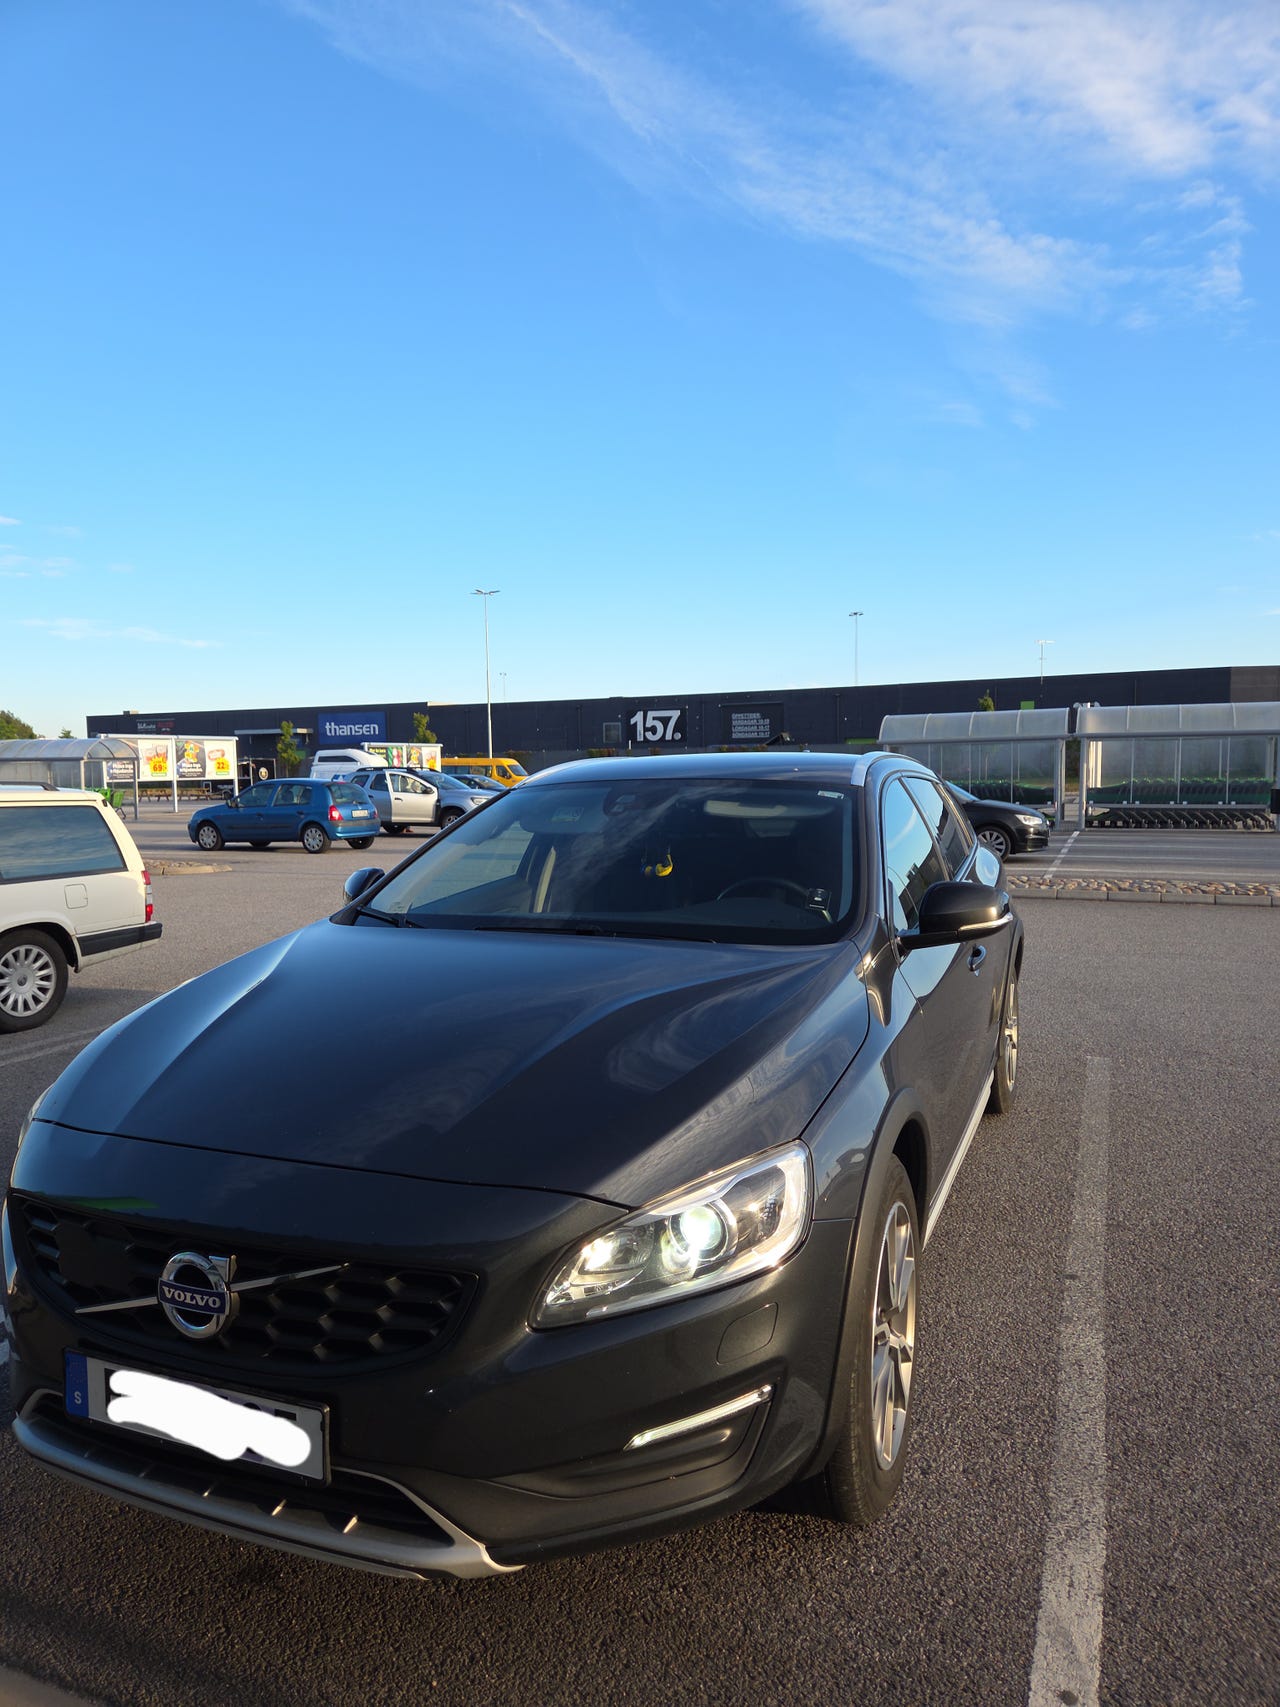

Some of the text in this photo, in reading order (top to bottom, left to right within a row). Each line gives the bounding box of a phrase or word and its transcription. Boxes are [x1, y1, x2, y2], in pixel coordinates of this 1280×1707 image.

[325, 722, 379, 736] thansen
[162, 1285, 221, 1308] VOLVO
[74, 1391, 82, 1405] S
